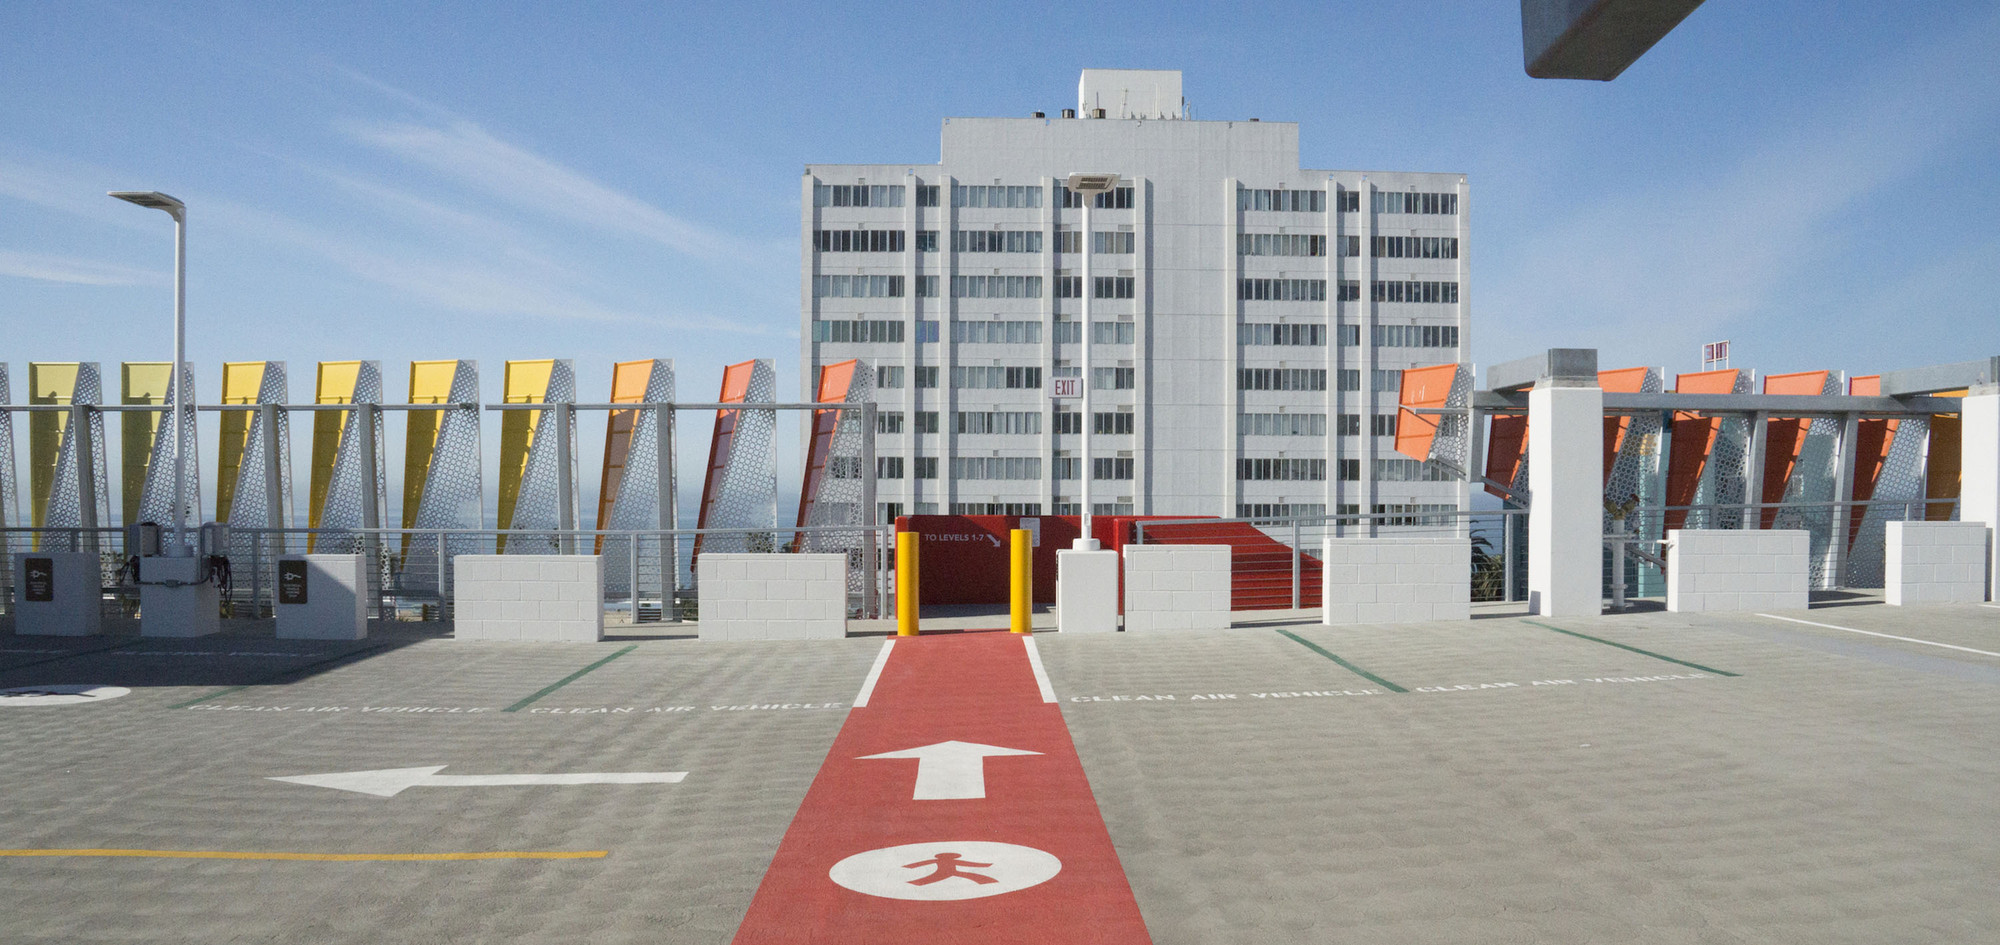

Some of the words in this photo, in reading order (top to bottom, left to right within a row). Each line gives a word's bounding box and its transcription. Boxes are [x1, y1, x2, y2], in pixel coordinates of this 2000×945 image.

[1055, 379, 1076, 396] EXIT
[925, 533, 937, 541] TO
[939, 533, 970, 542] LEVELS
[972, 533, 985, 541] 1-7
[1415, 681, 1521, 693] CLEAN
[1583, 673, 1715, 683] VEHICLE
[1070, 694, 1177, 703] CLEAN
[1191, 693, 1239, 701] AIR
[1250, 688, 1385, 699] VEHICLE
[187, 704, 291, 713] CLEAN
[295, 705, 350, 713] AIR
[360, 706, 497, 714] VEHICLE
[529, 706, 635, 714] CLEAN
[643, 705, 696, 713] AIR
[710, 702, 845, 712] VEHICLE
